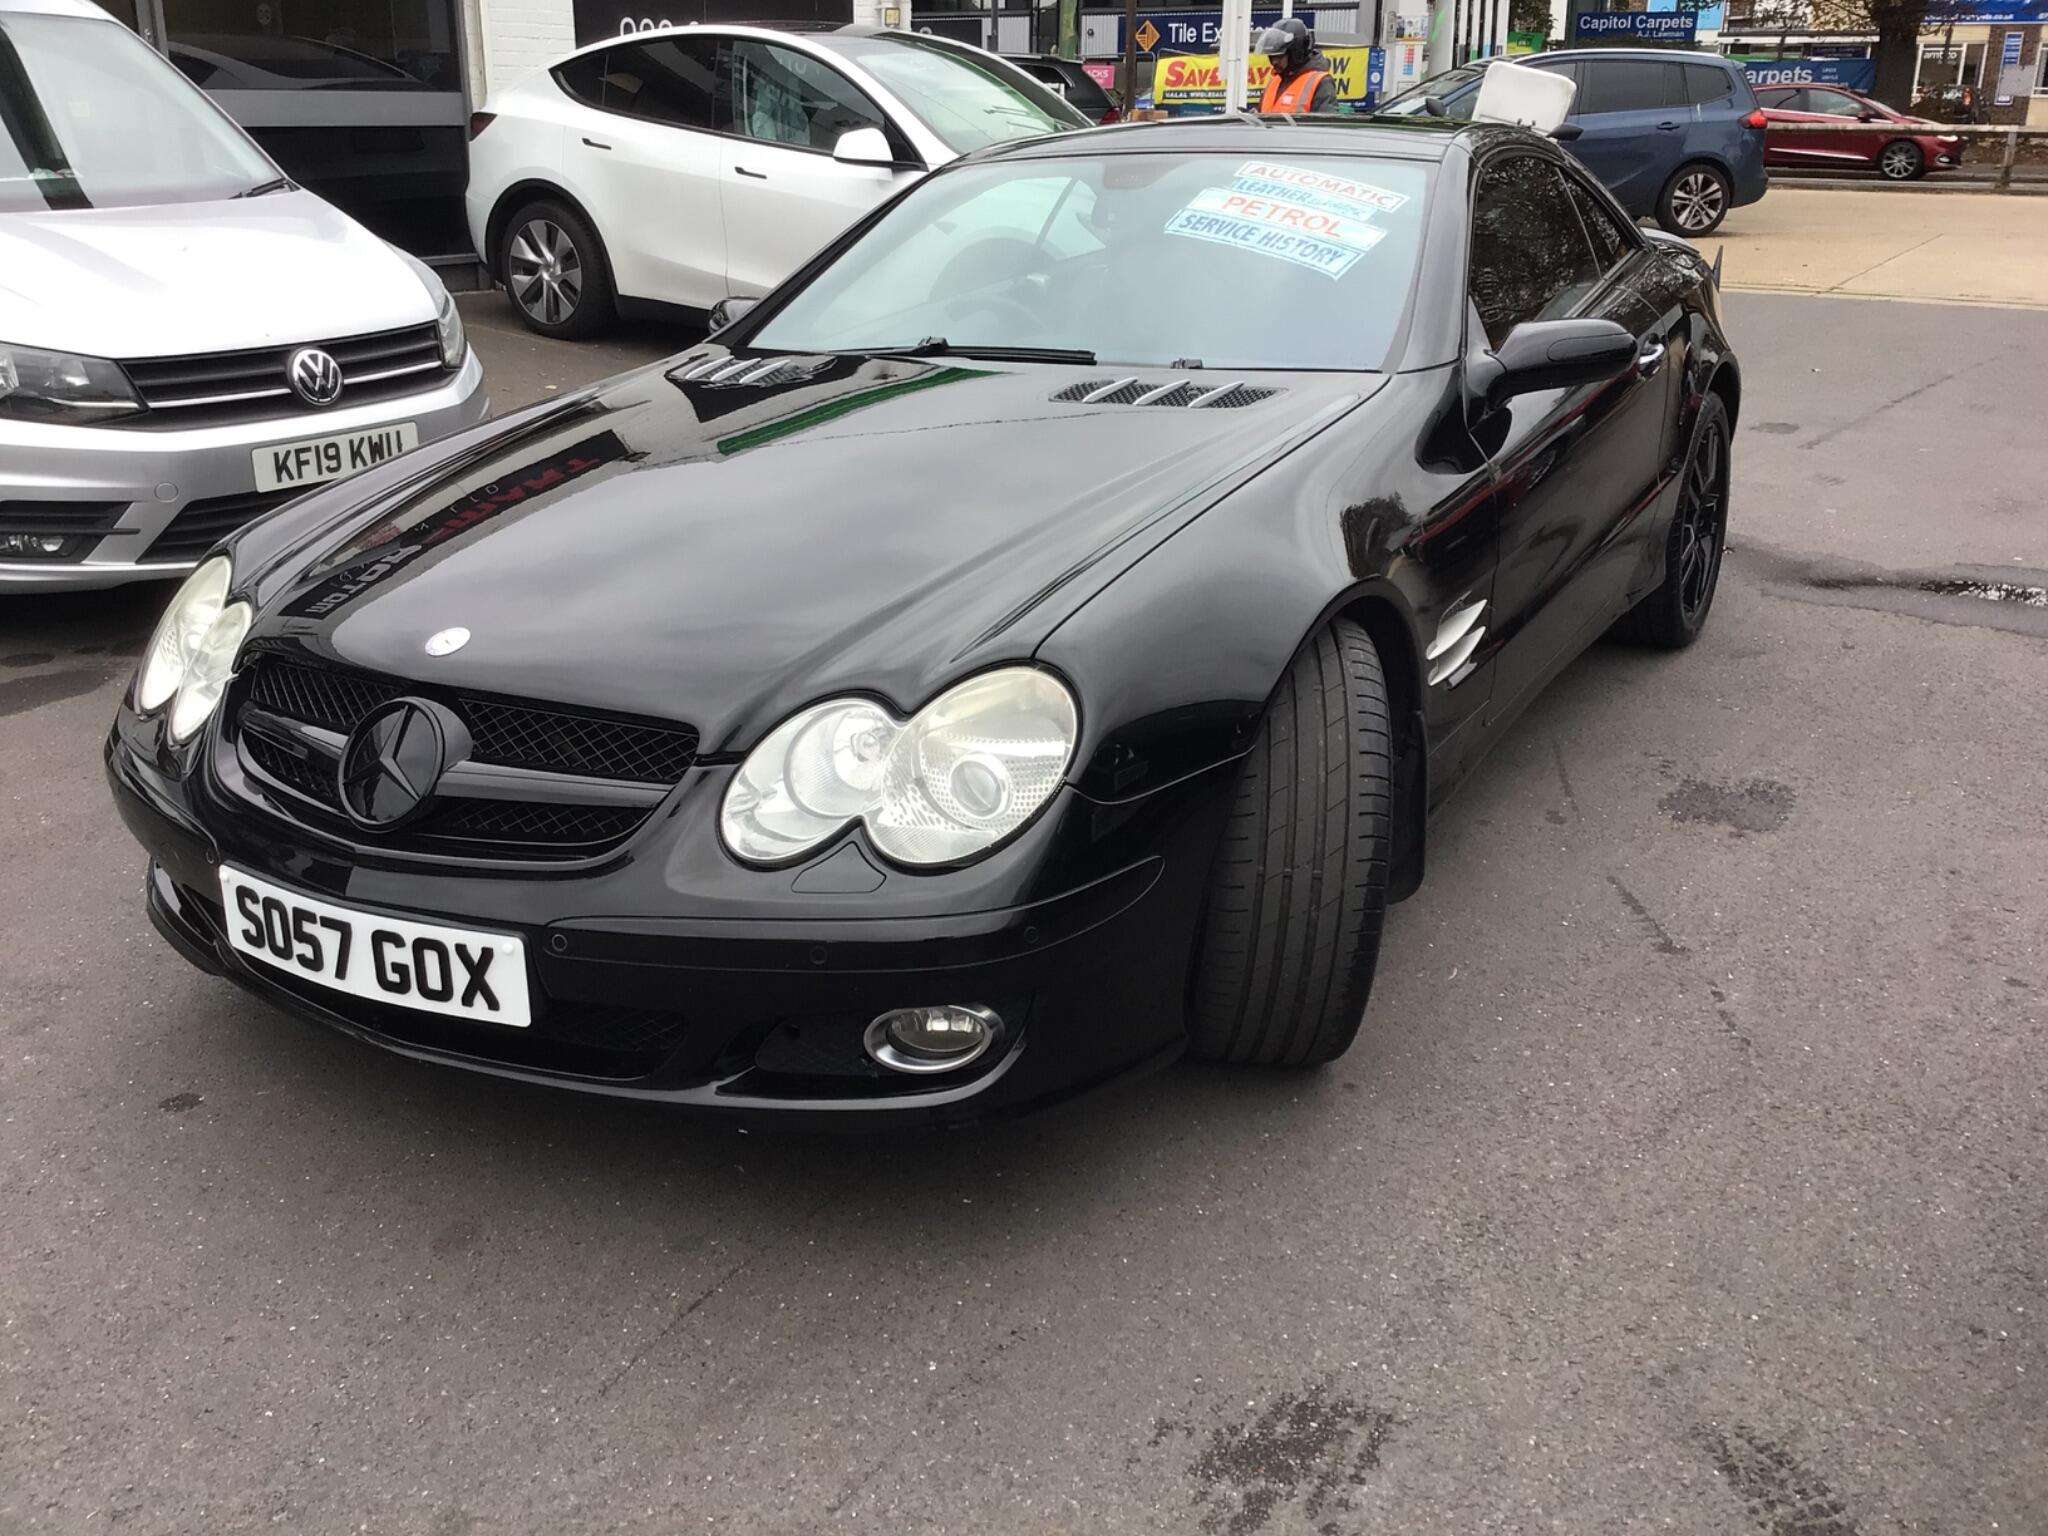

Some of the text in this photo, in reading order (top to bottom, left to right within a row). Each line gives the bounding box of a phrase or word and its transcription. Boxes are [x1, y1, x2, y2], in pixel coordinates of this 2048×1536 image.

[1167, 22, 1197, 43] Tile
[1579, 15, 1694, 31] Capitol Carpets
[1746, 65, 1813, 85] arpets
[1250, 165, 1395, 207] AUTOMATIC
[1220, 195, 1342, 238] PETROL
[1178, 213, 1345, 266] SERVICE HISTORY
[272, 441, 342, 484] KF19
[371, 928, 501, 1012] GOX
